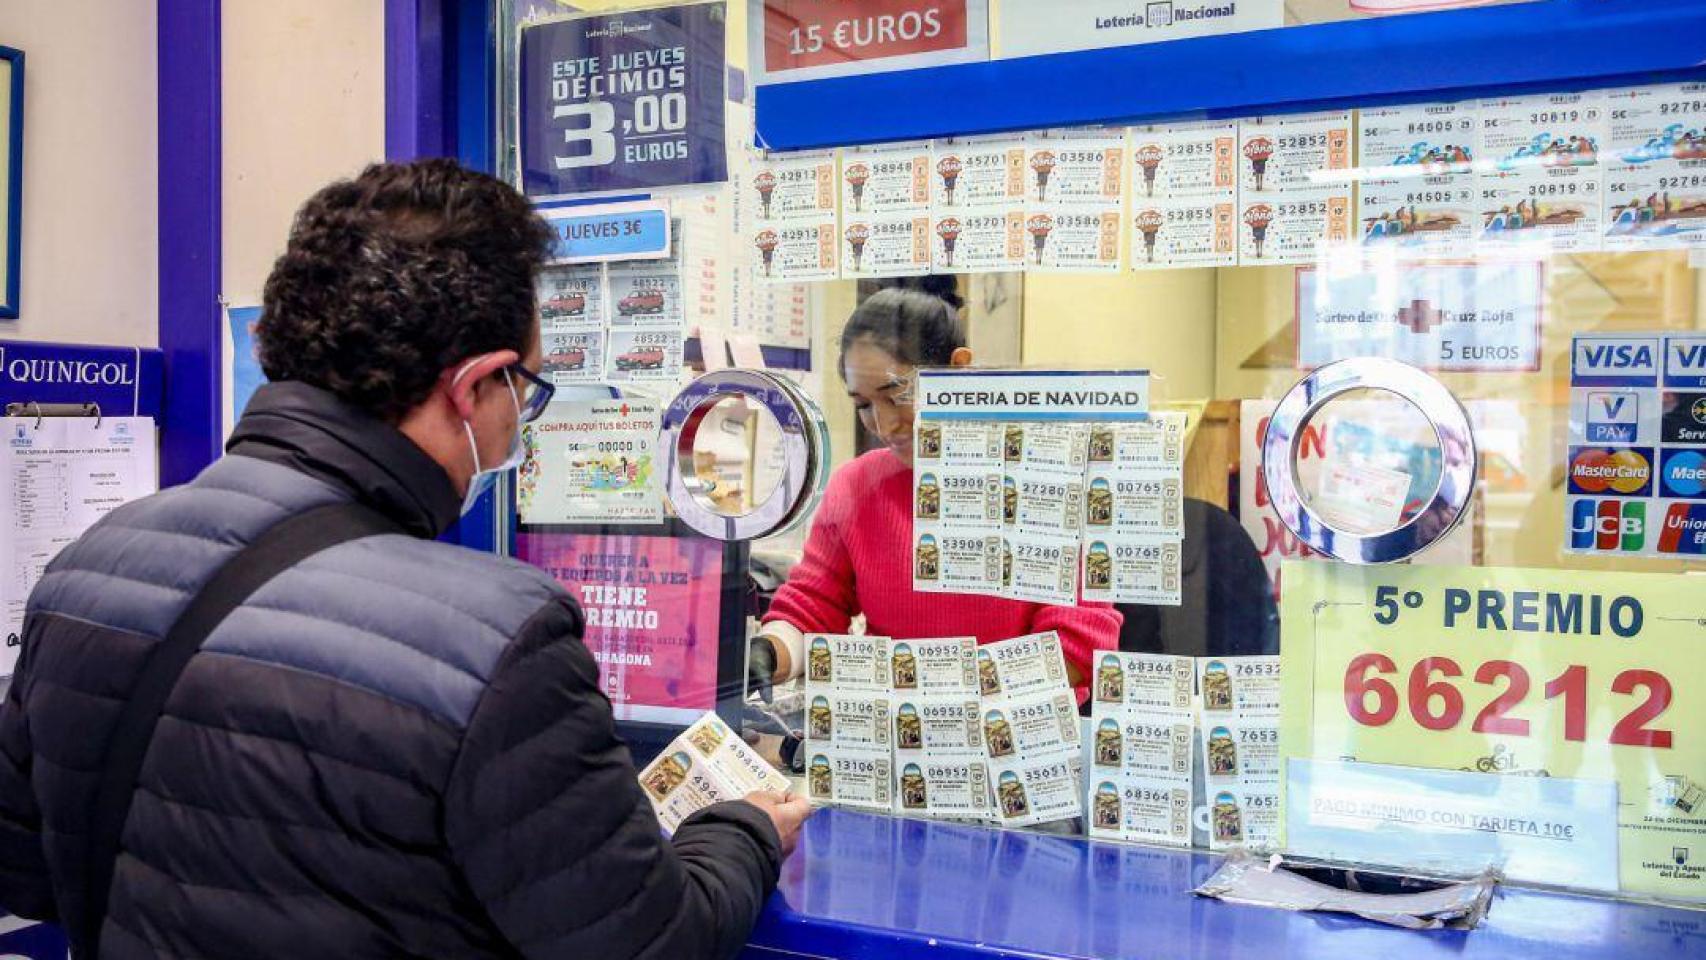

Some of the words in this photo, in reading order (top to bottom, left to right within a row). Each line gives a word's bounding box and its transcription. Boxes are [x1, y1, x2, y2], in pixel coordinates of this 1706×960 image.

[1174, 3, 1235, 22] Nacional
[789, 24, 823, 55] 15
[553, 57, 600, 79] ESTE
[608, 47, 686, 73] JUEVES
[1612, 110, 1627, 119] 5€
[1279, 135, 1327, 149] 52852
[624, 140, 688, 164] EUROS
[1168, 143, 1213, 156] 52855
[1529, 184, 1576, 195] 30819
[1610, 183, 1626, 192] 5€
[1407, 191, 1452, 203] 84505
[1168, 207, 1212, 221] 52855
[1279, 202, 1327, 215] 52852
[565, 222, 619, 240] JUEVES
[623, 219, 642, 236] 3€
[781, 229, 818, 241] 42913
[1441, 341, 1453, 359] 5
[1462, 345, 1519, 360] EUROS
[1583, 345, 1652, 369] VISA
[9, 359, 134, 386] QUINIGOL
[926, 392, 1009, 405] LOTERIA
[1014, 392, 1040, 405] DE
[1046, 392, 1139, 406] NAVIDAD
[1602, 397, 1625, 420] V
[538, 424, 575, 433] COMPRA
[599, 423, 615, 432] TUS
[615, 421, 655, 432] BOLETOS
[1596, 426, 1626, 439] PAY
[1574, 464, 1648, 478] MasterCard
[943, 477, 984, 488] 53909
[1116, 481, 1162, 493] 00765
[1572, 515, 1642, 535] JCB
[942, 538, 984, 550] 53909
[1017, 545, 1060, 559] 27280
[581, 585, 647, 606] TIENE
[1443, 588, 1644, 638] PREMIO
[836, 641, 873, 652] 13106
[918, 645, 959, 656] 06952
[997, 642, 1038, 660] 35651
[1127, 661, 1173, 673] 68364
[836, 701, 873, 712] 13106
[1344, 652, 1674, 749] 66212
[923, 706, 963, 717] 06952
[1012, 703, 1052, 720] 35651
[1126, 725, 1170, 737] 68364
[836, 760, 874, 772] 13106
[928, 767, 968, 778] 06952
[1025, 765, 1067, 781] 35651
[1125, 789, 1169, 801] 68364
[1431, 810, 1465, 825] CON
[1470, 815, 1538, 835] TARJETA
[1543, 822, 1575, 838] 10€
